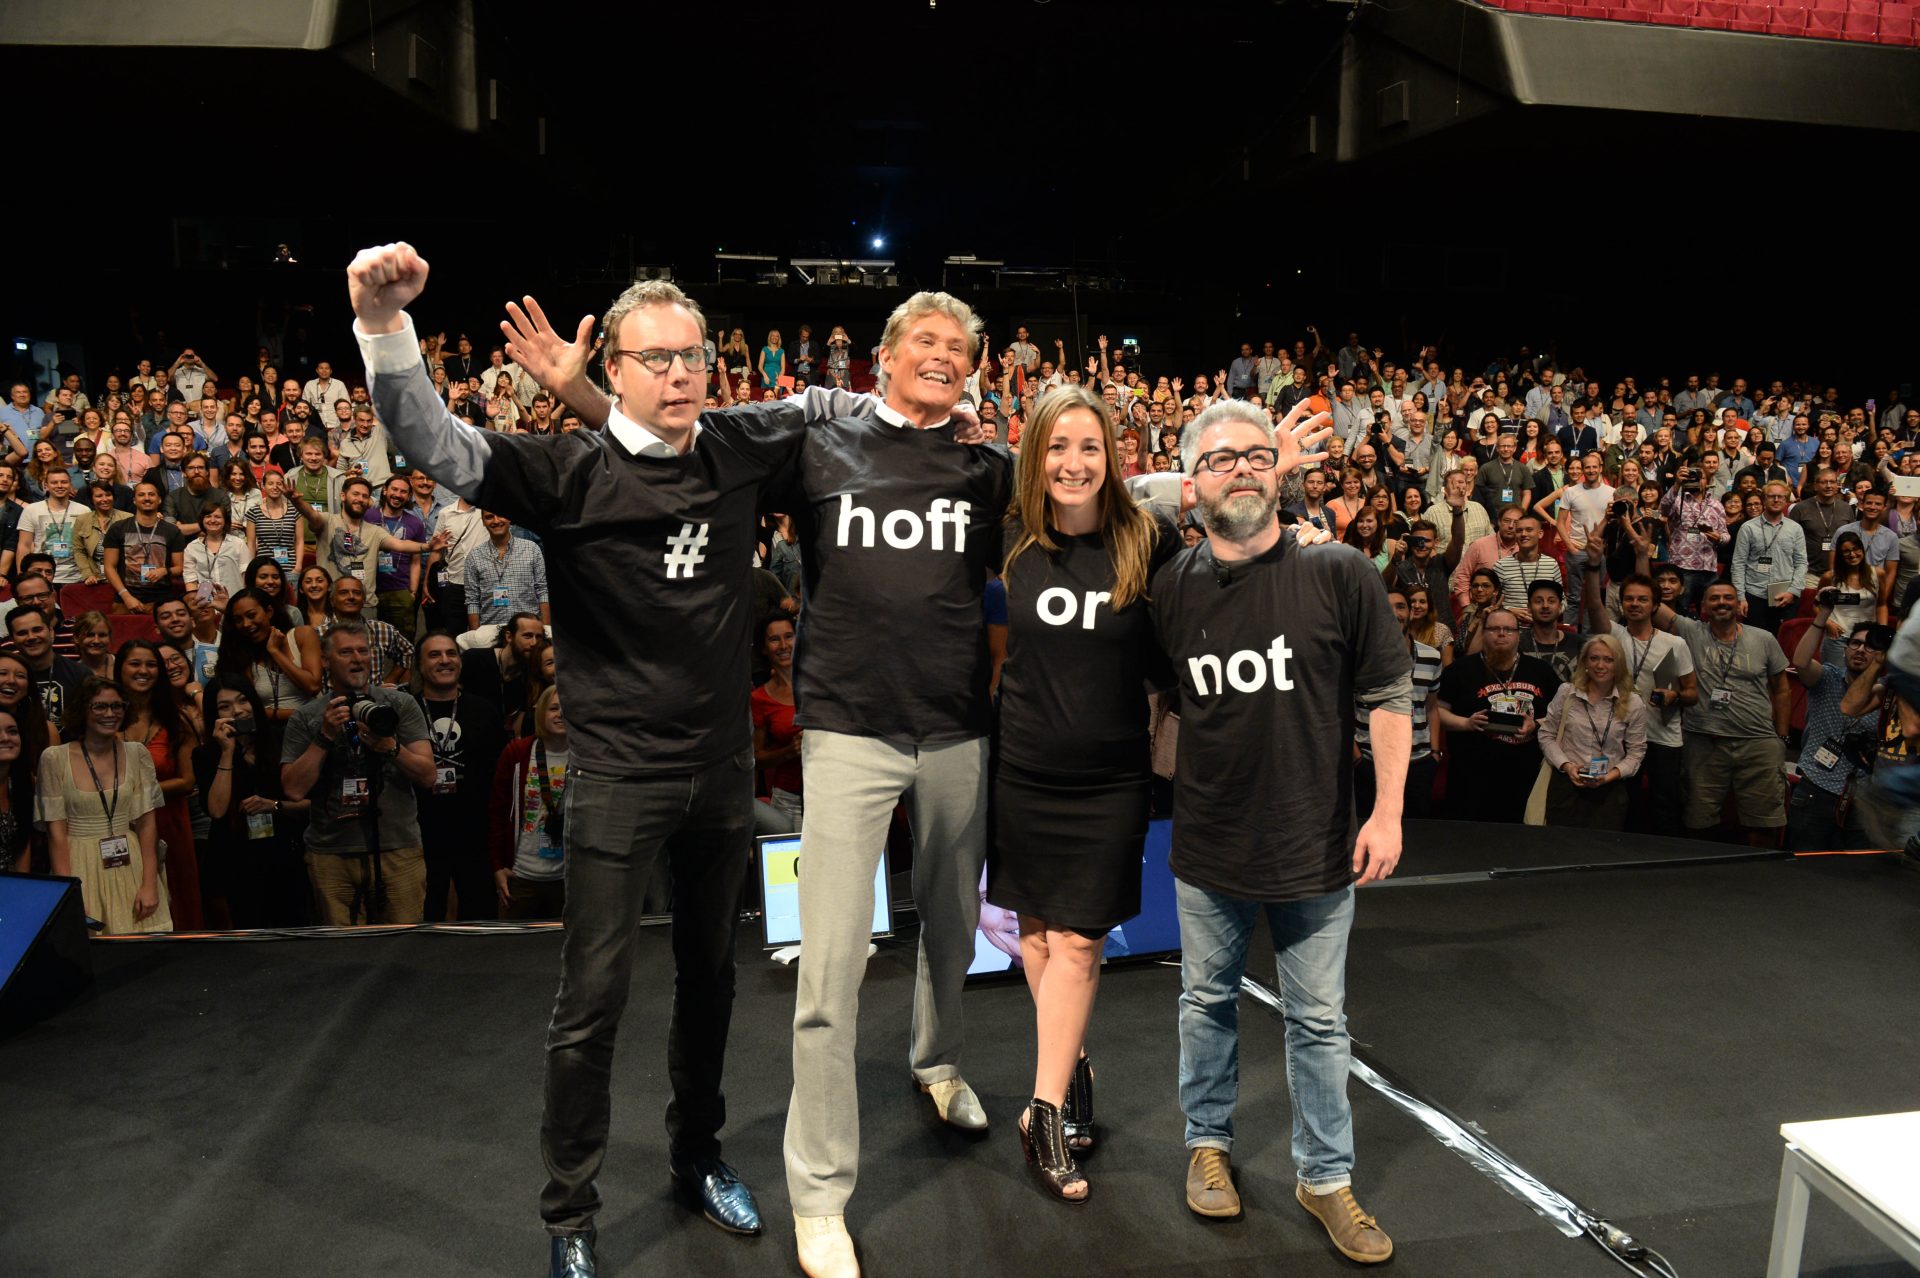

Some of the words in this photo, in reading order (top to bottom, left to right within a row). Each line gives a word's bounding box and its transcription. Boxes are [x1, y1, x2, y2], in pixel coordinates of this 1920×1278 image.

[663, 523, 709, 579] #
[836, 493, 972, 553] hoff
[1036, 587, 1111, 630] or
[1187, 634, 1295, 696] not
